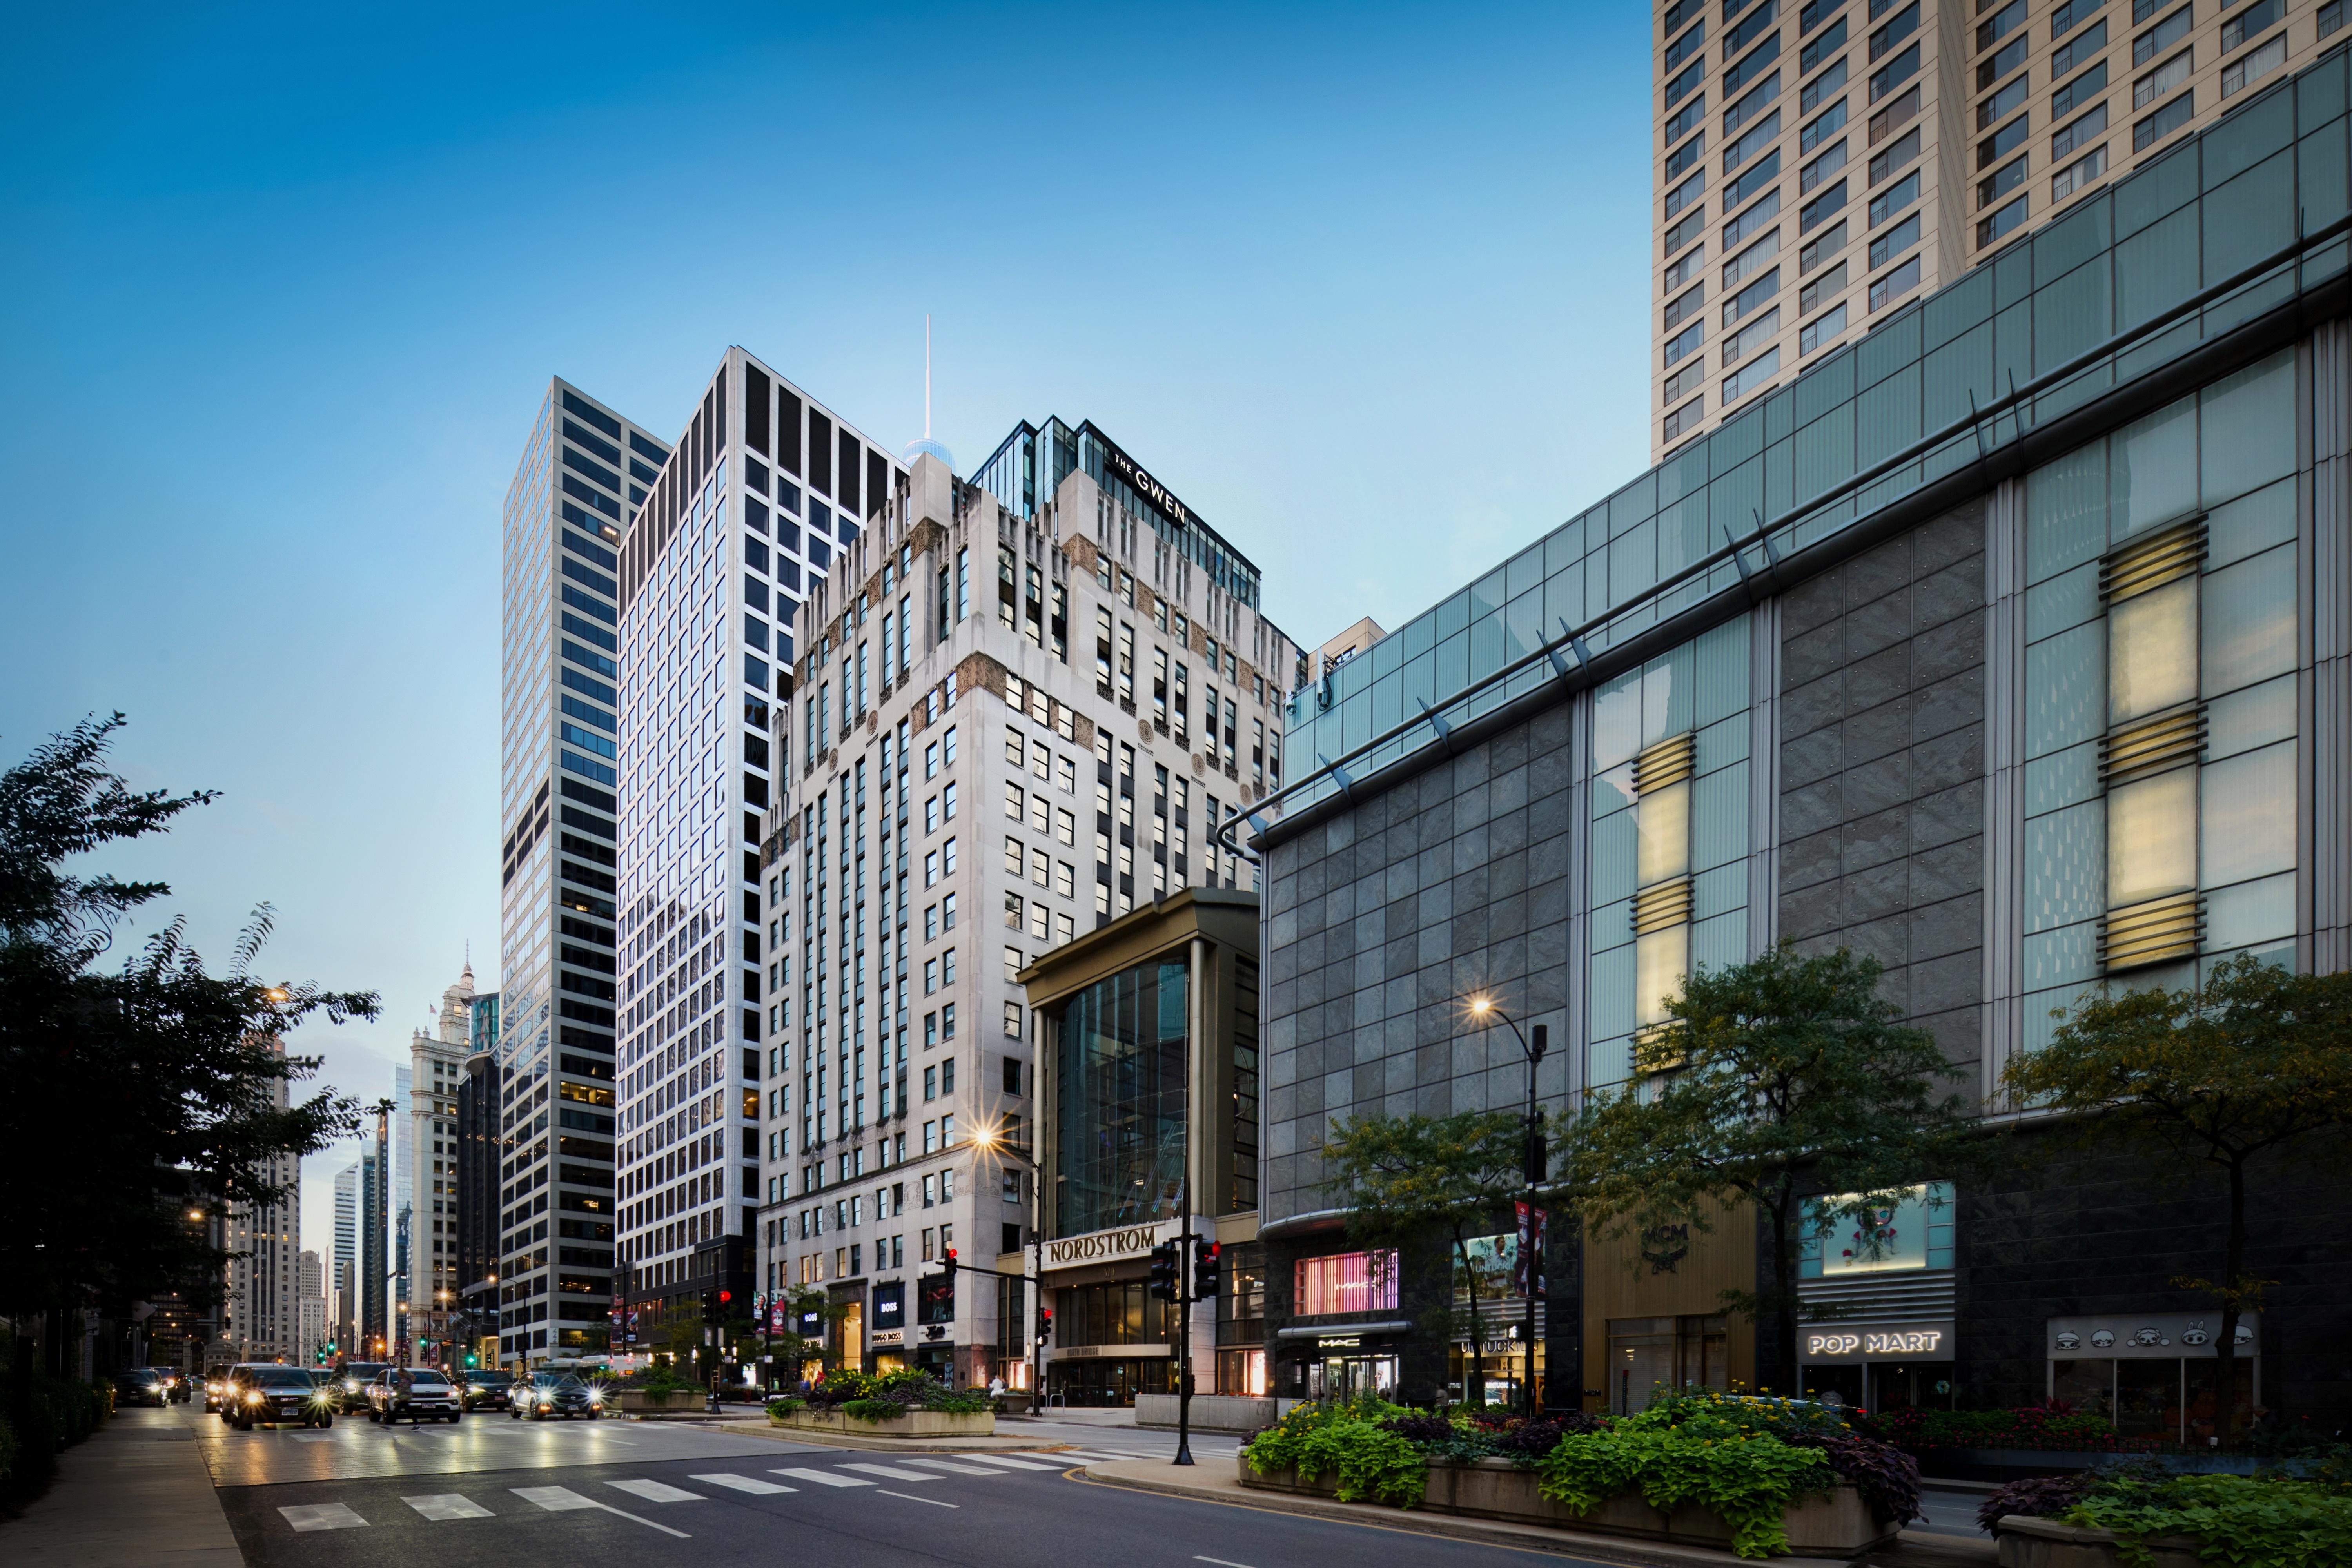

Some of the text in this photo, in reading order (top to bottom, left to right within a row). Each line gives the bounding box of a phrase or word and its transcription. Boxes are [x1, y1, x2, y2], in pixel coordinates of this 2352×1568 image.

[1115, 454, 1185, 523] THE GWEN
[1051, 1227, 1155, 1262] NORDSTROM
[881, 1302, 897, 1312] BOSS
[805, 1313, 817, 1322] BOSS
[1809, 1332, 1940, 1353] POP MART
[1081, 1347, 1098, 1356] BRIDGE
